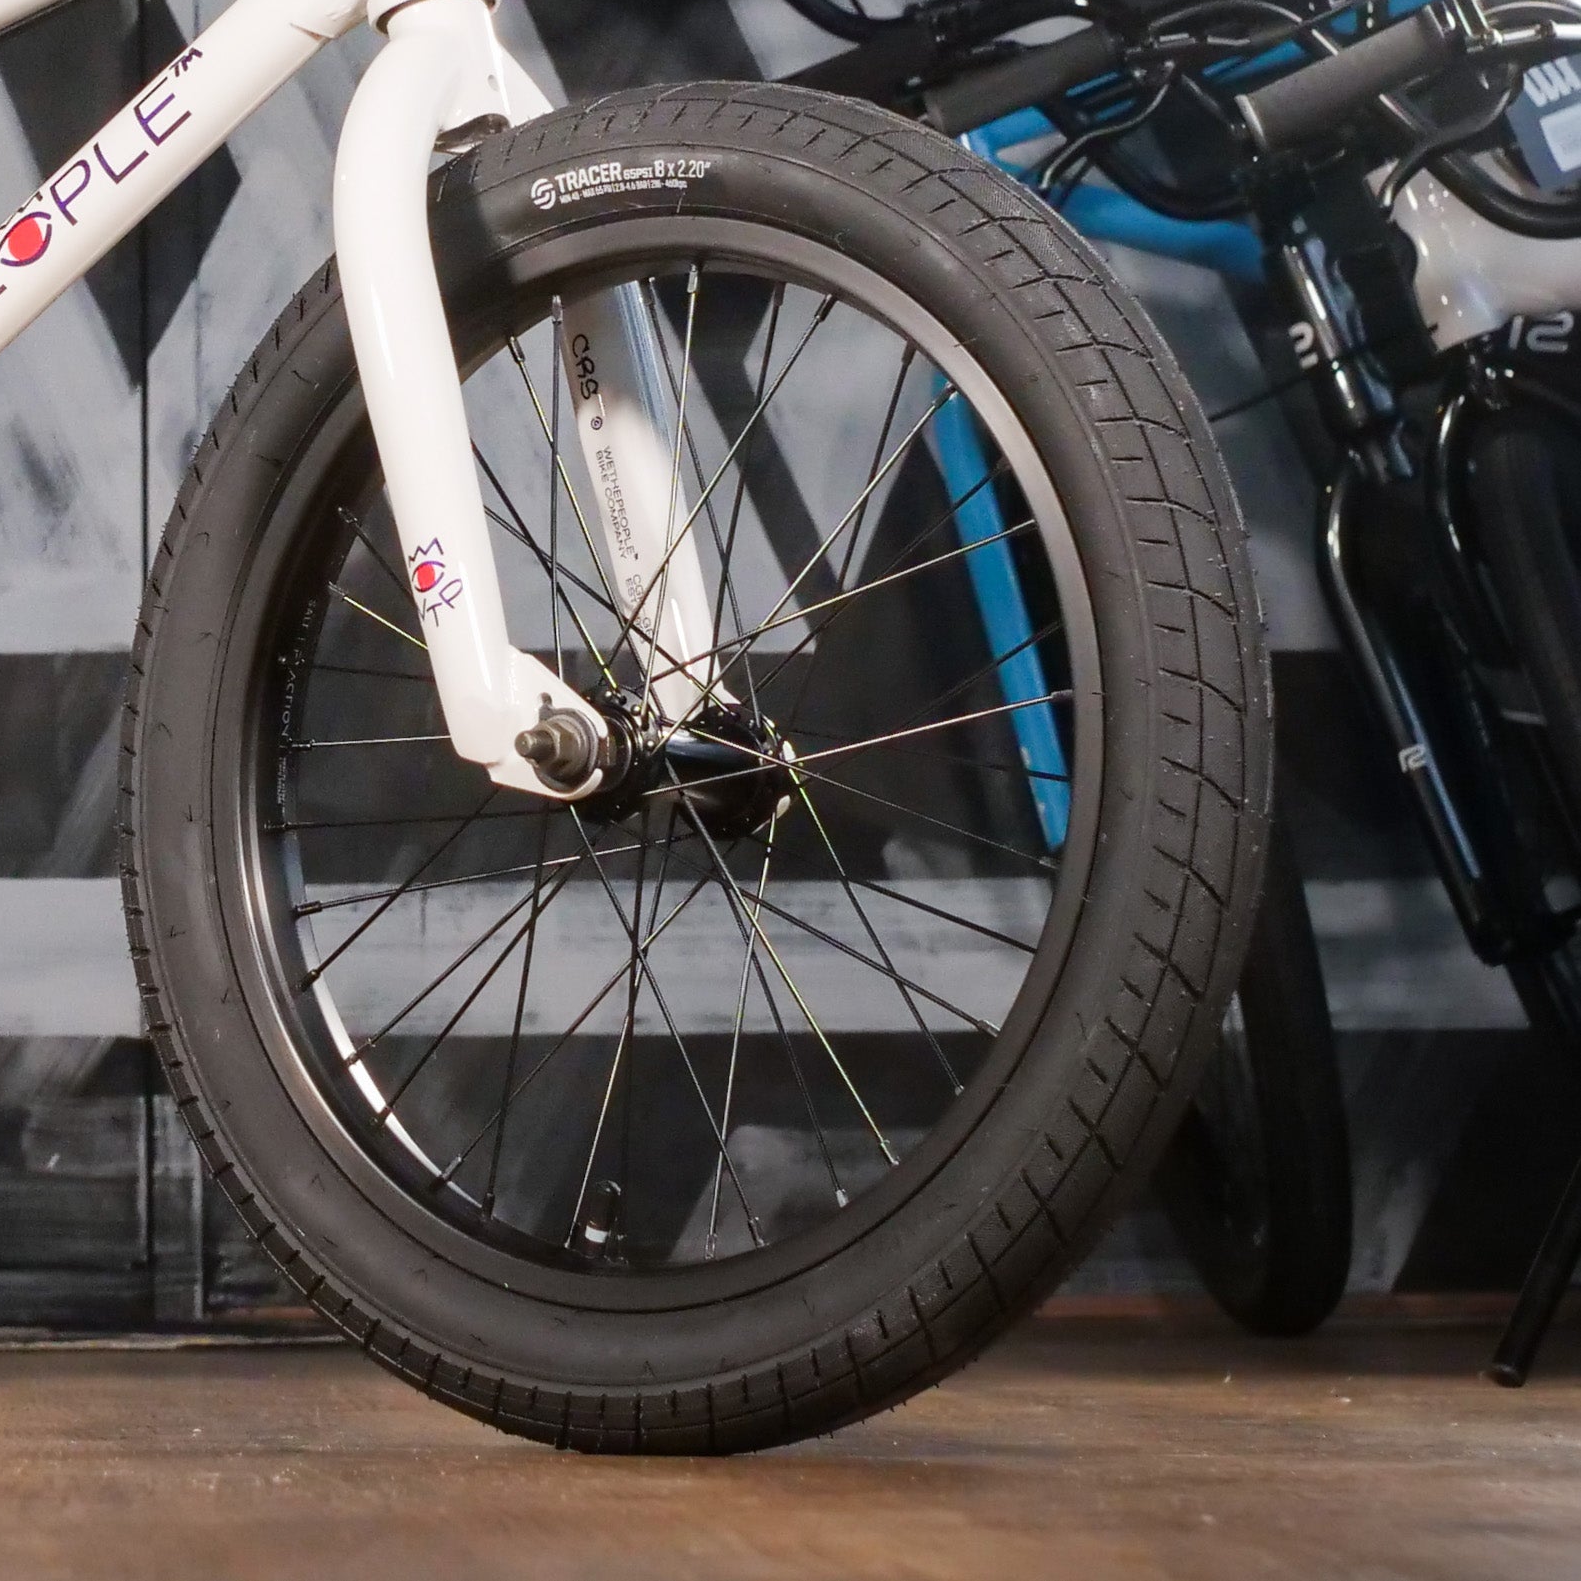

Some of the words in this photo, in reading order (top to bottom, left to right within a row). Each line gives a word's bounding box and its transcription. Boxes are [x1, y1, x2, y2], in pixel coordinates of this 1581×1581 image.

[554, 162, 622, 194] TRACER
[572, 333, 599, 400] CRS
[596, 450, 610, 483] BIKE
[604, 486, 628, 560] COMPANY
